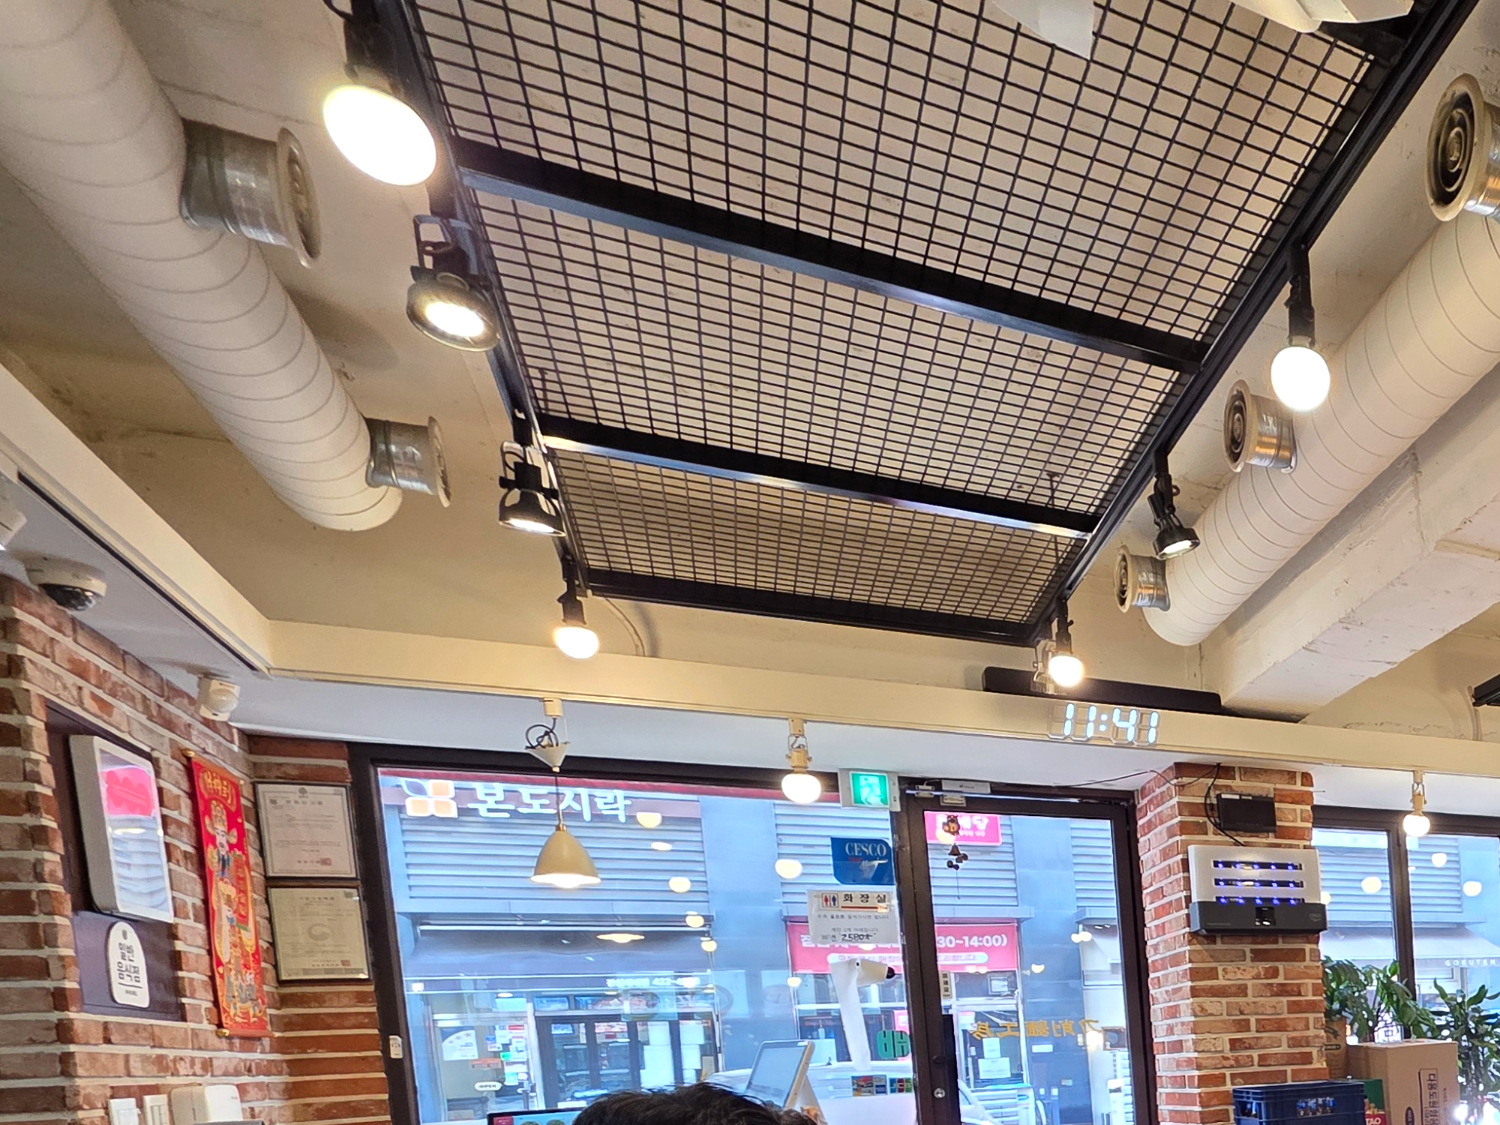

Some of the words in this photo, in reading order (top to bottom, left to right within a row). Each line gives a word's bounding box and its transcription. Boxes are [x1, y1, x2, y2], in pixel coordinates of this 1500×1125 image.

[1063, 702, 1159, 744] 11:41
[467, 782, 632, 823] 본도시락
[845, 842, 887, 857] CESCO
[117, 961, 141, 983] 음식점
